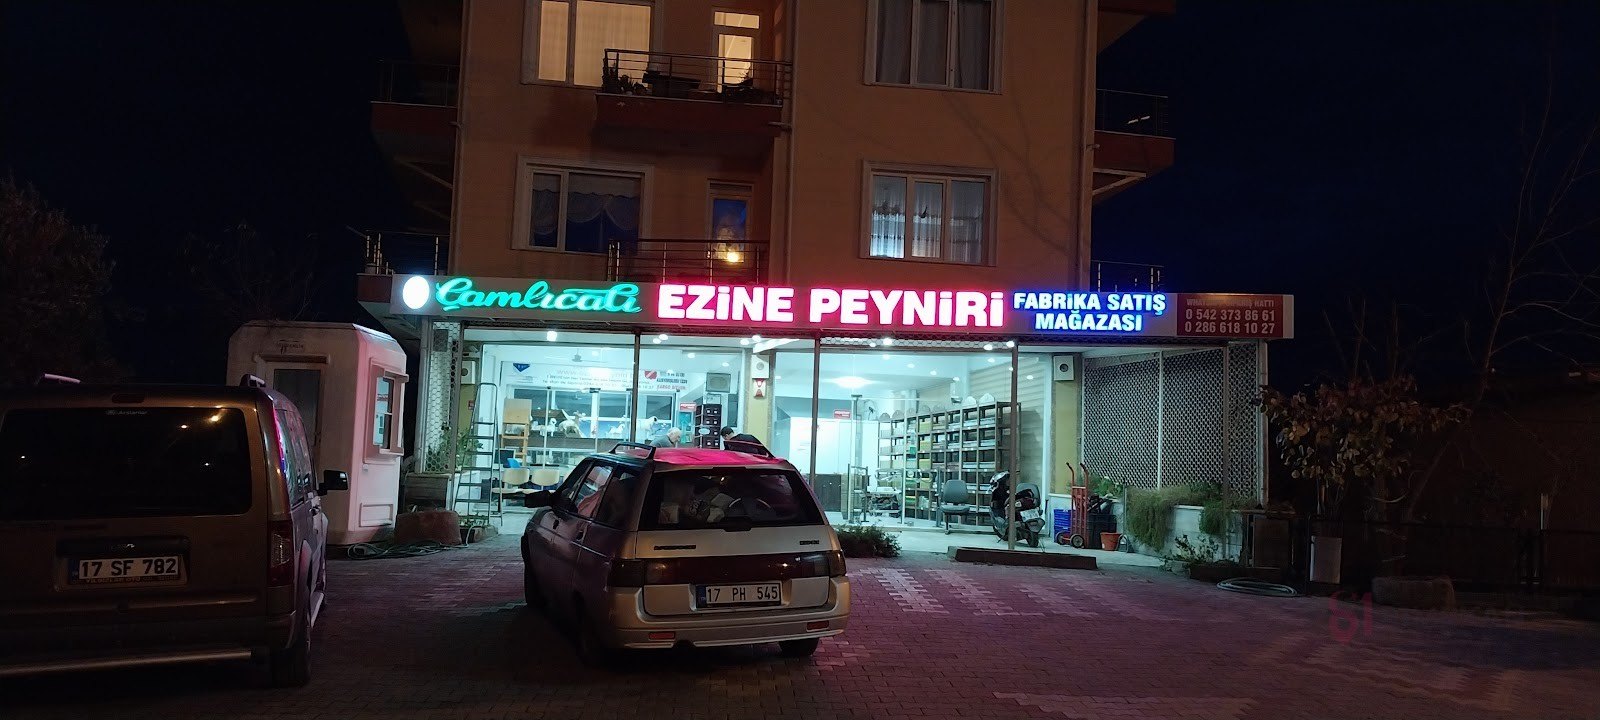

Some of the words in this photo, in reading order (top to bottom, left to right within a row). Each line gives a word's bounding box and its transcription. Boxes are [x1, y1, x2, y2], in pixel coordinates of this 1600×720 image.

[1107, 293, 1166, 315] SATIŞ
[1035, 310, 1142, 332] MAĞAZASI
[1185, 308, 1193, 320] 0
[1196, 309, 1217, 320] 542
[1220, 309, 1241, 321] 373
[1245, 310, 1258, 321] 86
[1261, 310, 1275, 321] 61
[1184, 321, 1192, 333] 0
[1195, 321, 1216, 333] 286
[1219, 322, 1240, 333] 618
[1244, 322, 1258, 334] 10
[1261, 322, 1275, 334] 27
[81, 561, 103, 577] 17
[110, 560, 134, 576] SF
[142, 558, 177, 575] 782
[707, 588, 721, 603] 17
[732, 587, 746, 601] PH
[757, 586, 778, 600] 545
